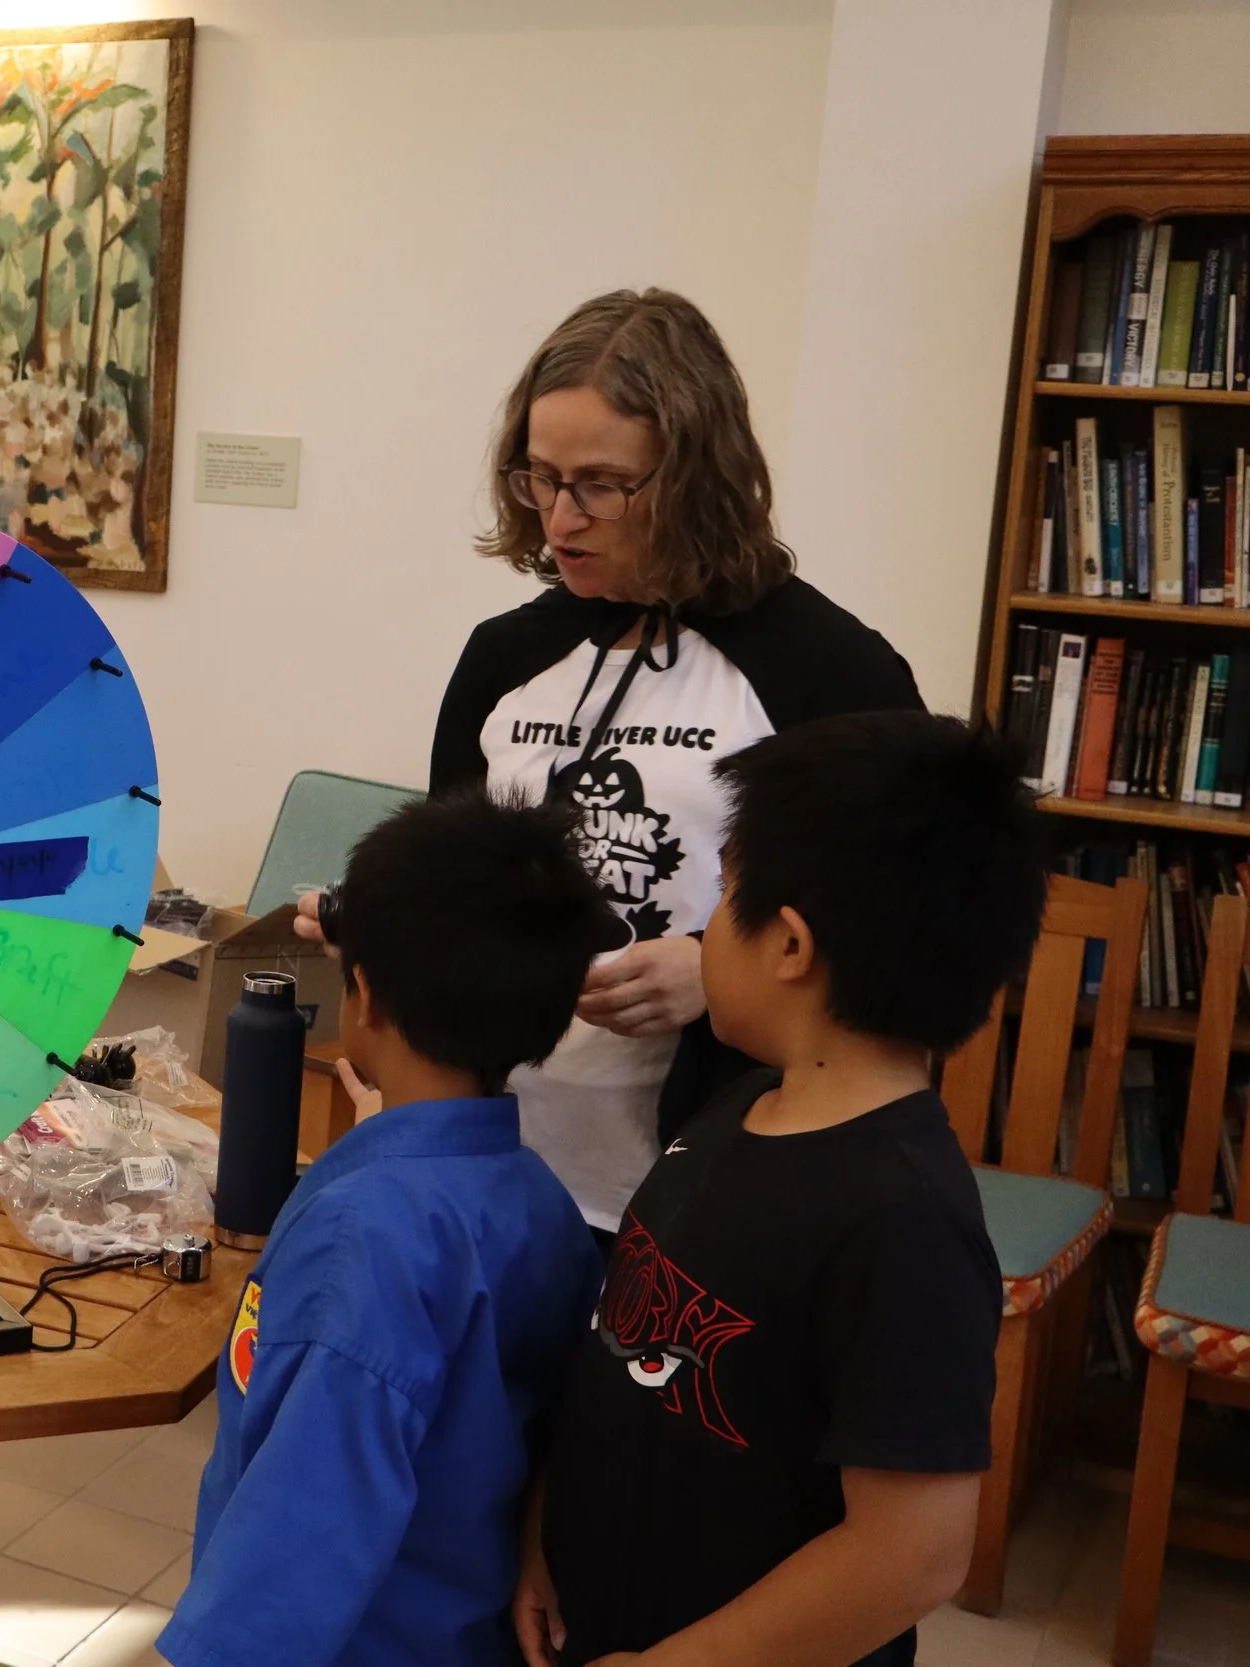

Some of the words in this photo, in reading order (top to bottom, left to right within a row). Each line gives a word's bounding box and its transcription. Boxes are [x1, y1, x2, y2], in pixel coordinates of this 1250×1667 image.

[1124, 322, 1140, 367] VICTORY
[1162, 481, 1176, 561] Protestantism
[511, 720, 581, 748] LITTLE
[591, 726, 657, 746] IVER
[663, 726, 716, 751] UCC
